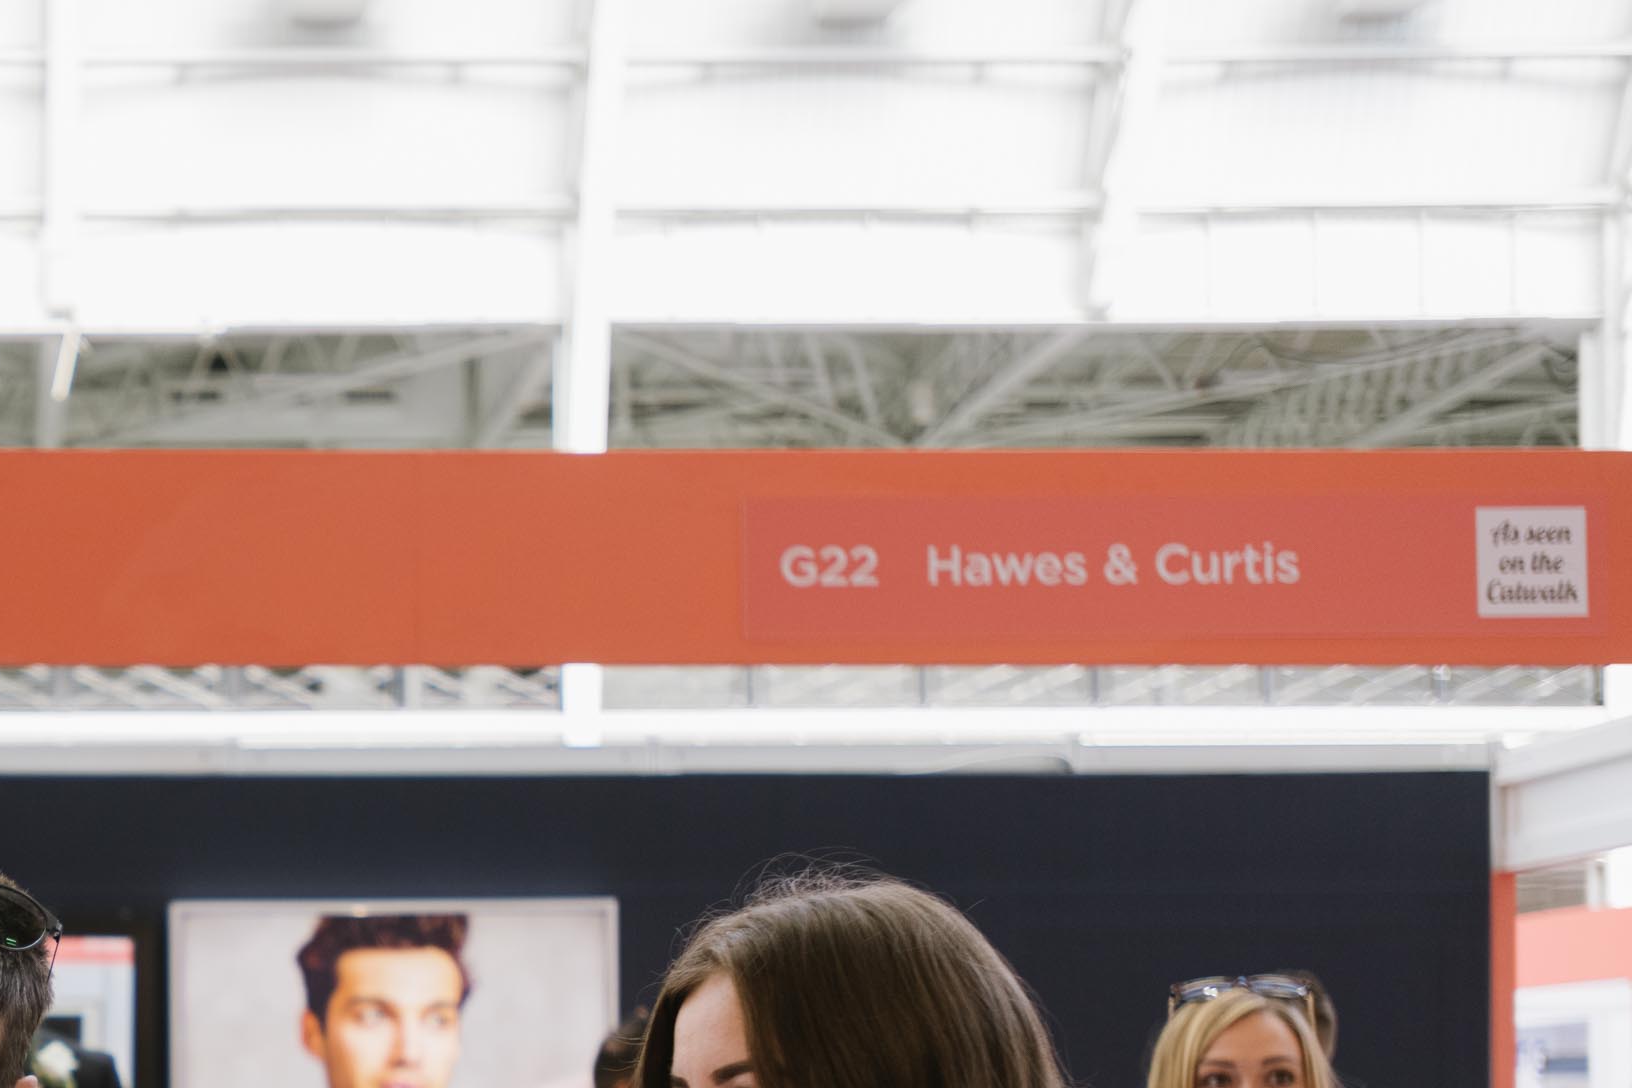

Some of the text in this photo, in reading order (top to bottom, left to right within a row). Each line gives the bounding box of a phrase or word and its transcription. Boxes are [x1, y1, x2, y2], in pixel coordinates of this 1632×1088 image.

[1490, 519, 1572, 547] As seen
[779, 541, 1300, 588] G22 Hawes & Curtis
[1498, 551, 1564, 574] on the
[1487, 579, 1578, 604] Catwalk
